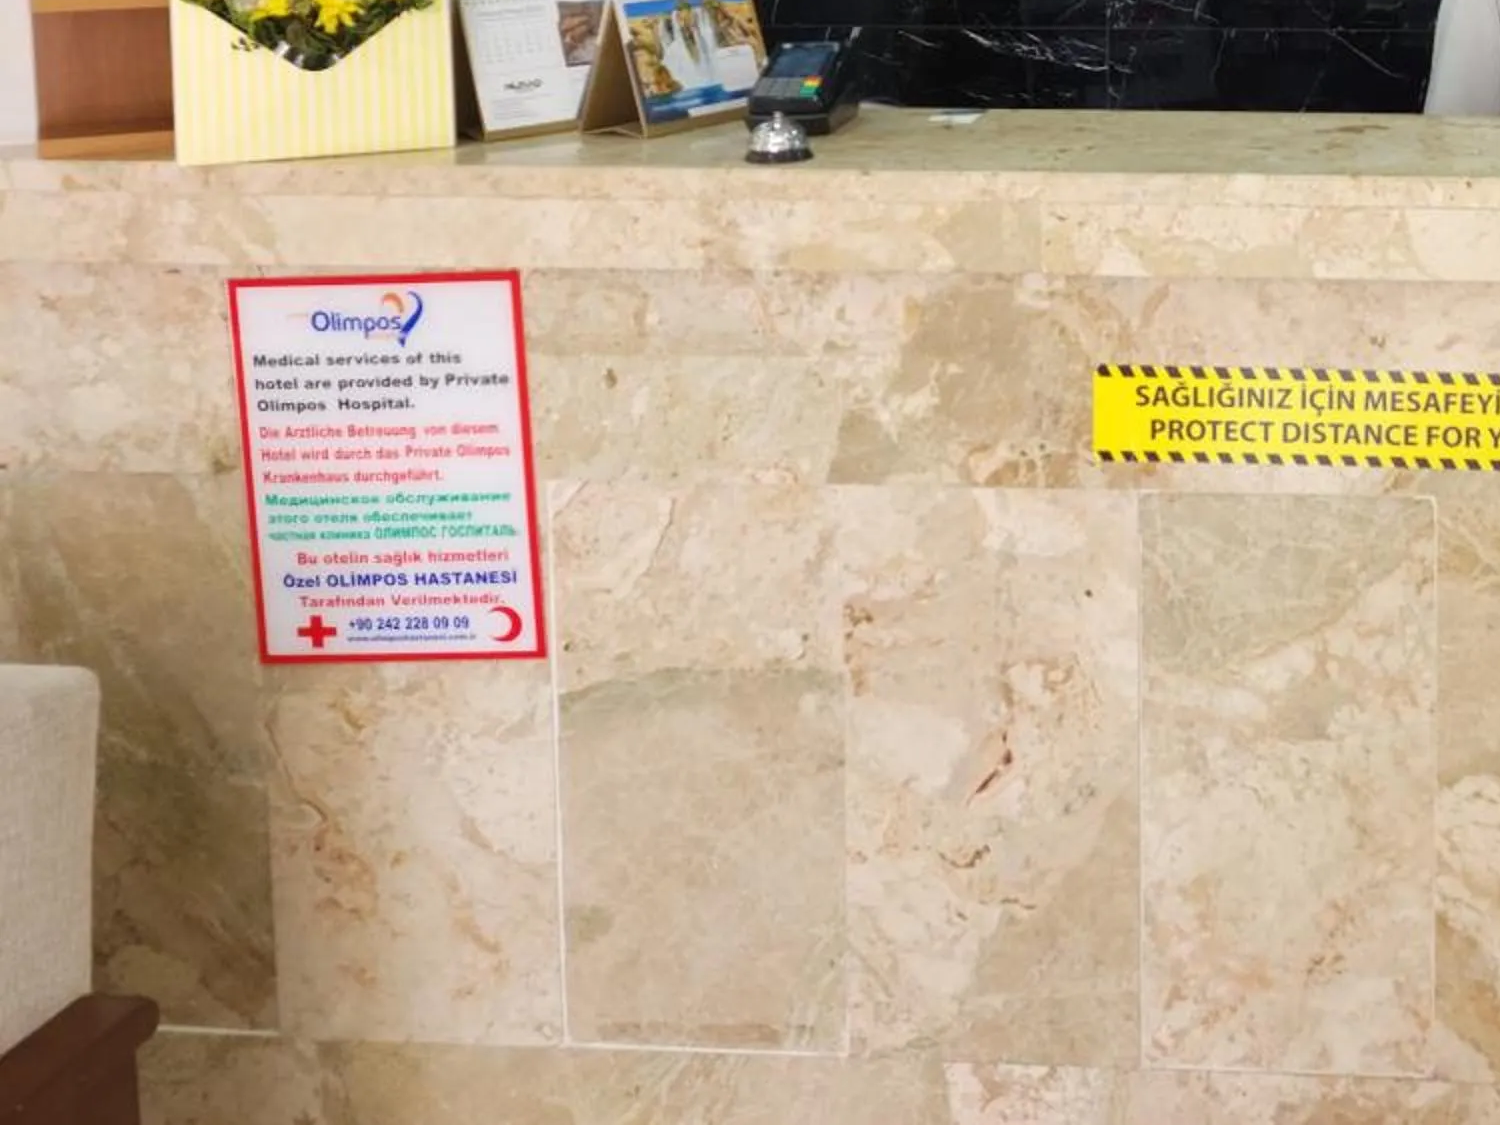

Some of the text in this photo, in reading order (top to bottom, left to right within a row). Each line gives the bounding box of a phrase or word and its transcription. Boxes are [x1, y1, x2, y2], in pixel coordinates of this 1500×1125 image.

[311, 310, 401, 339] Olimpos
[253, 351, 461, 367] Medical services of this
[255, 373, 509, 392] hotel are provided by Private
[257, 397, 415, 414] Olimpos Hospital.
[1135, 381, 1292, 409] SAĞLIĞINIZ
[1301, 381, 1355, 416] İÇİN
[1364, 387, 1500, 416] MESAFEYİ
[259, 426, 279, 439] Die
[424, 425, 446, 435] von
[1150, 418, 1274, 443] PROTECT
[1282, 422, 1417, 446] DISTANCE
[1426, 425, 1481, 449] FOR
[261, 444, 511, 462] Hotel wird durch das Private Olimpos
[262, 471, 349, 484] Krankenhaus
[297, 548, 509, 567] Bu otelin sağlık hizmetleri
[283, 567, 517, 588] Özel OLİMPOS HASTANESİ
[300, 594, 385, 608] Tarafından
[348, 615, 470, 631] +90 242 228 09 09
